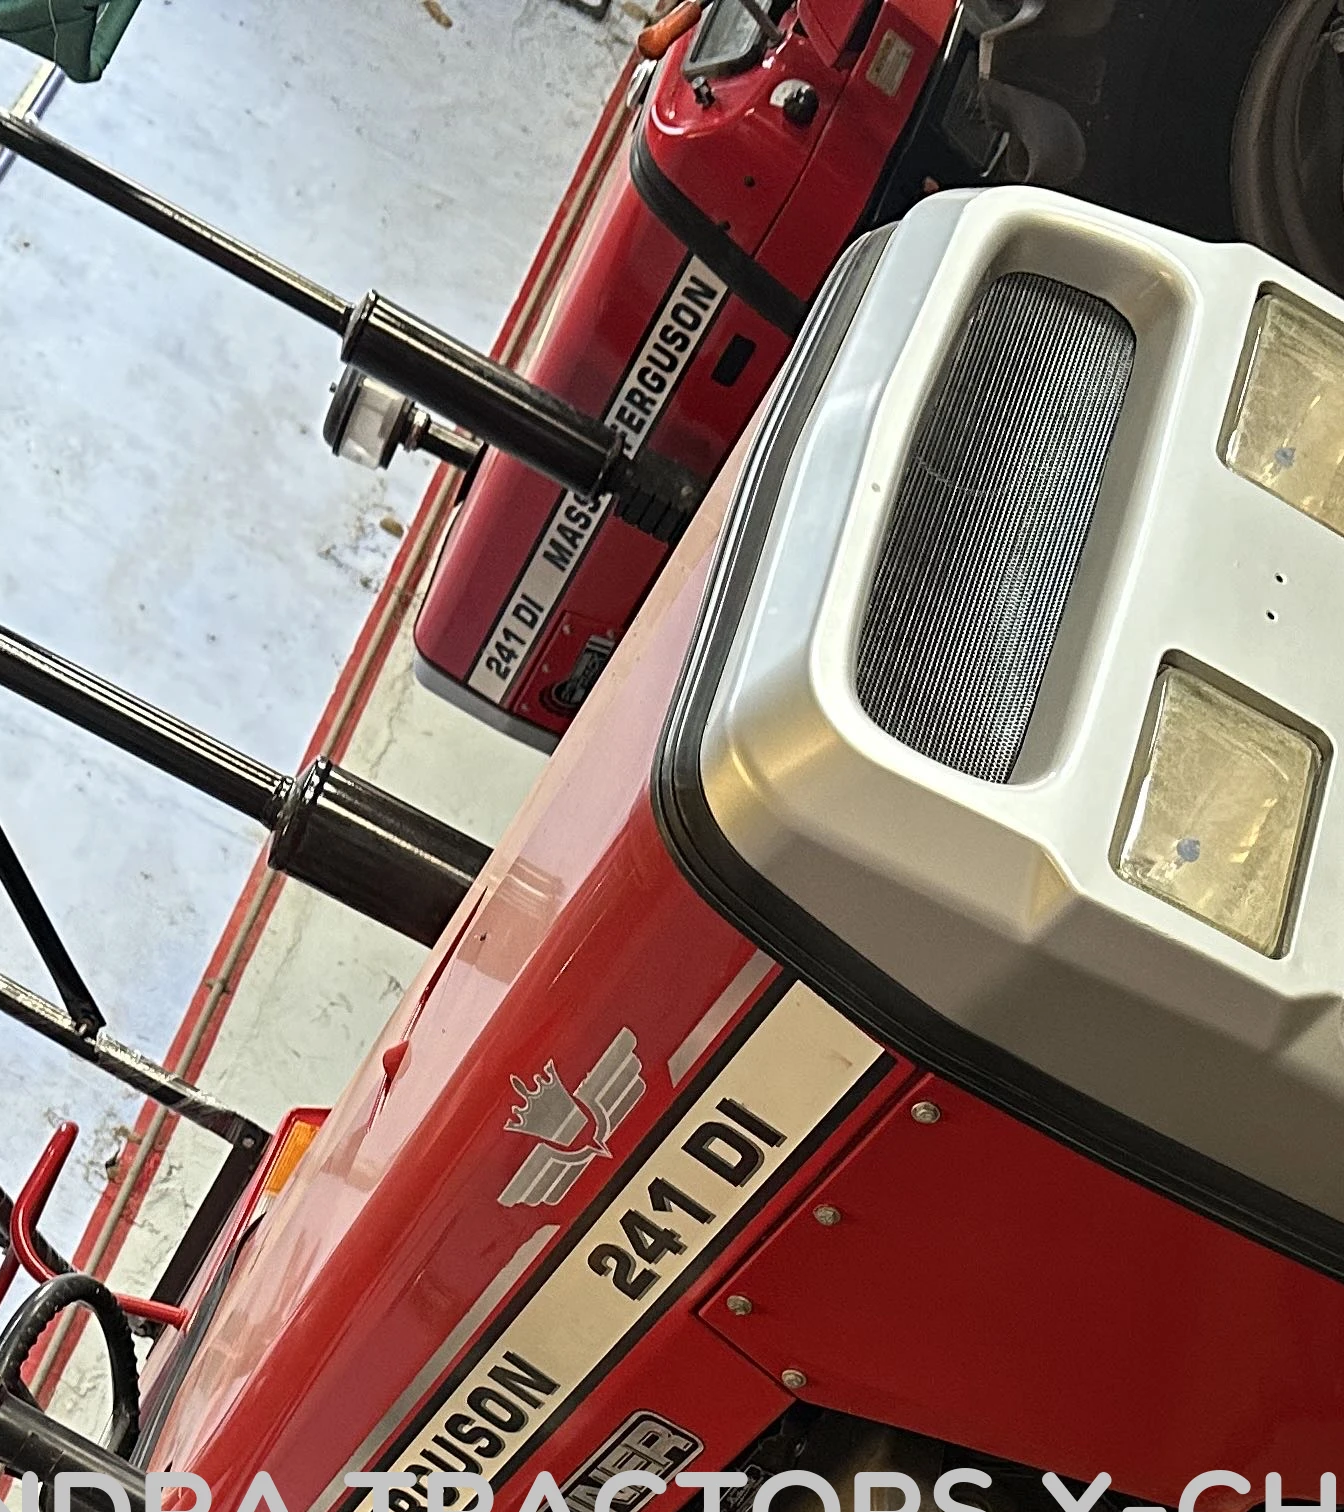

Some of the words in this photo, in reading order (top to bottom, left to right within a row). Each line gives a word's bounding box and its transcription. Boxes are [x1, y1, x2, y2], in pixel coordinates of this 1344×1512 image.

[486, 625, 528, 682] 241
[513, 593, 546, 638] DI
[542, 491, 606, 573] MASS
[587, 1176, 716, 1303] 241
[680, 1097, 787, 1190] DI
